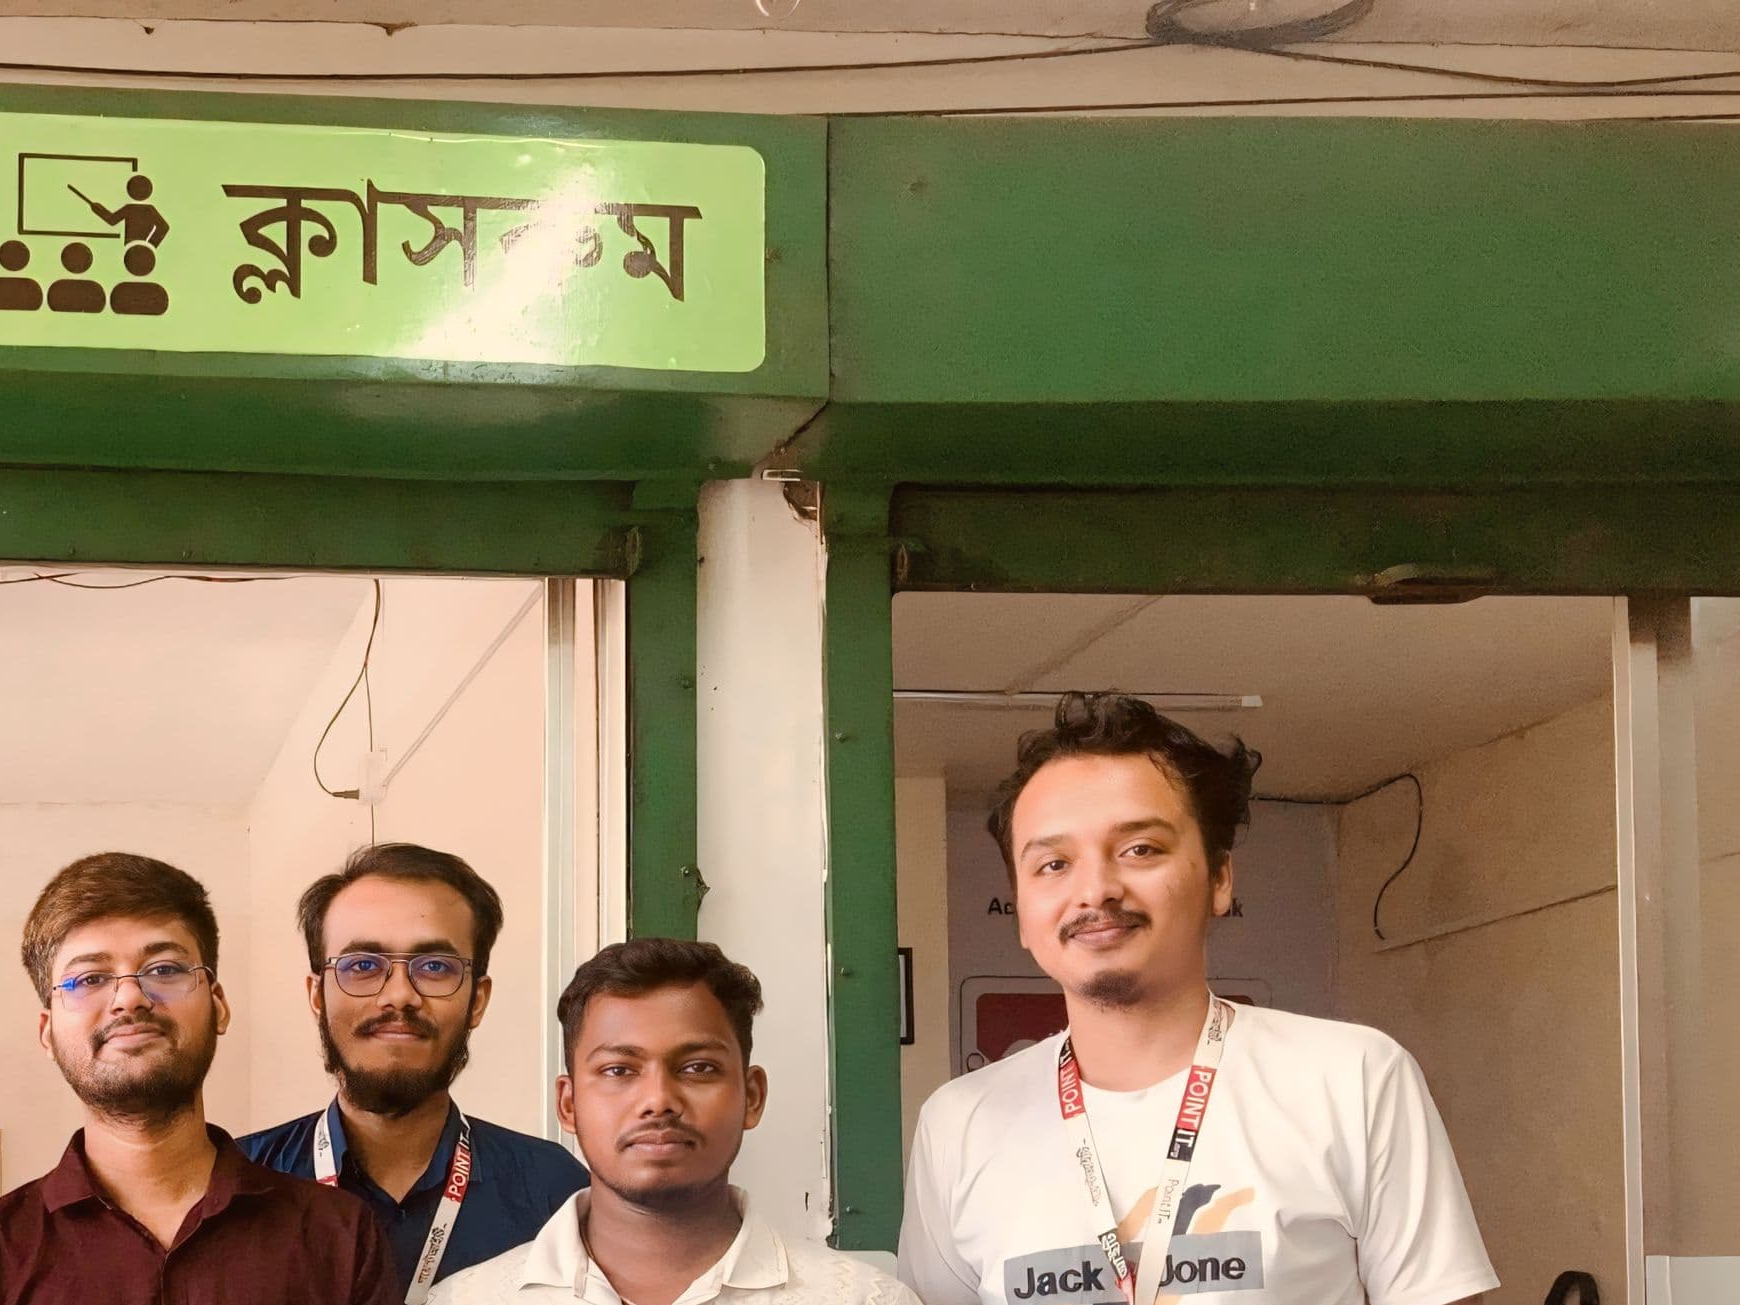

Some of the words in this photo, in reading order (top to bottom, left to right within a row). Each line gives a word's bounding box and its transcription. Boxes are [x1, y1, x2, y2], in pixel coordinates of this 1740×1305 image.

[1061, 1068, 1083, 1114] POINT
[1179, 1069, 1213, 1130] POINT
[1175, 1128, 1197, 1148] IT
[450, 1152, 471, 1198] POINT
[1014, 1260, 1105, 1300] Jack
